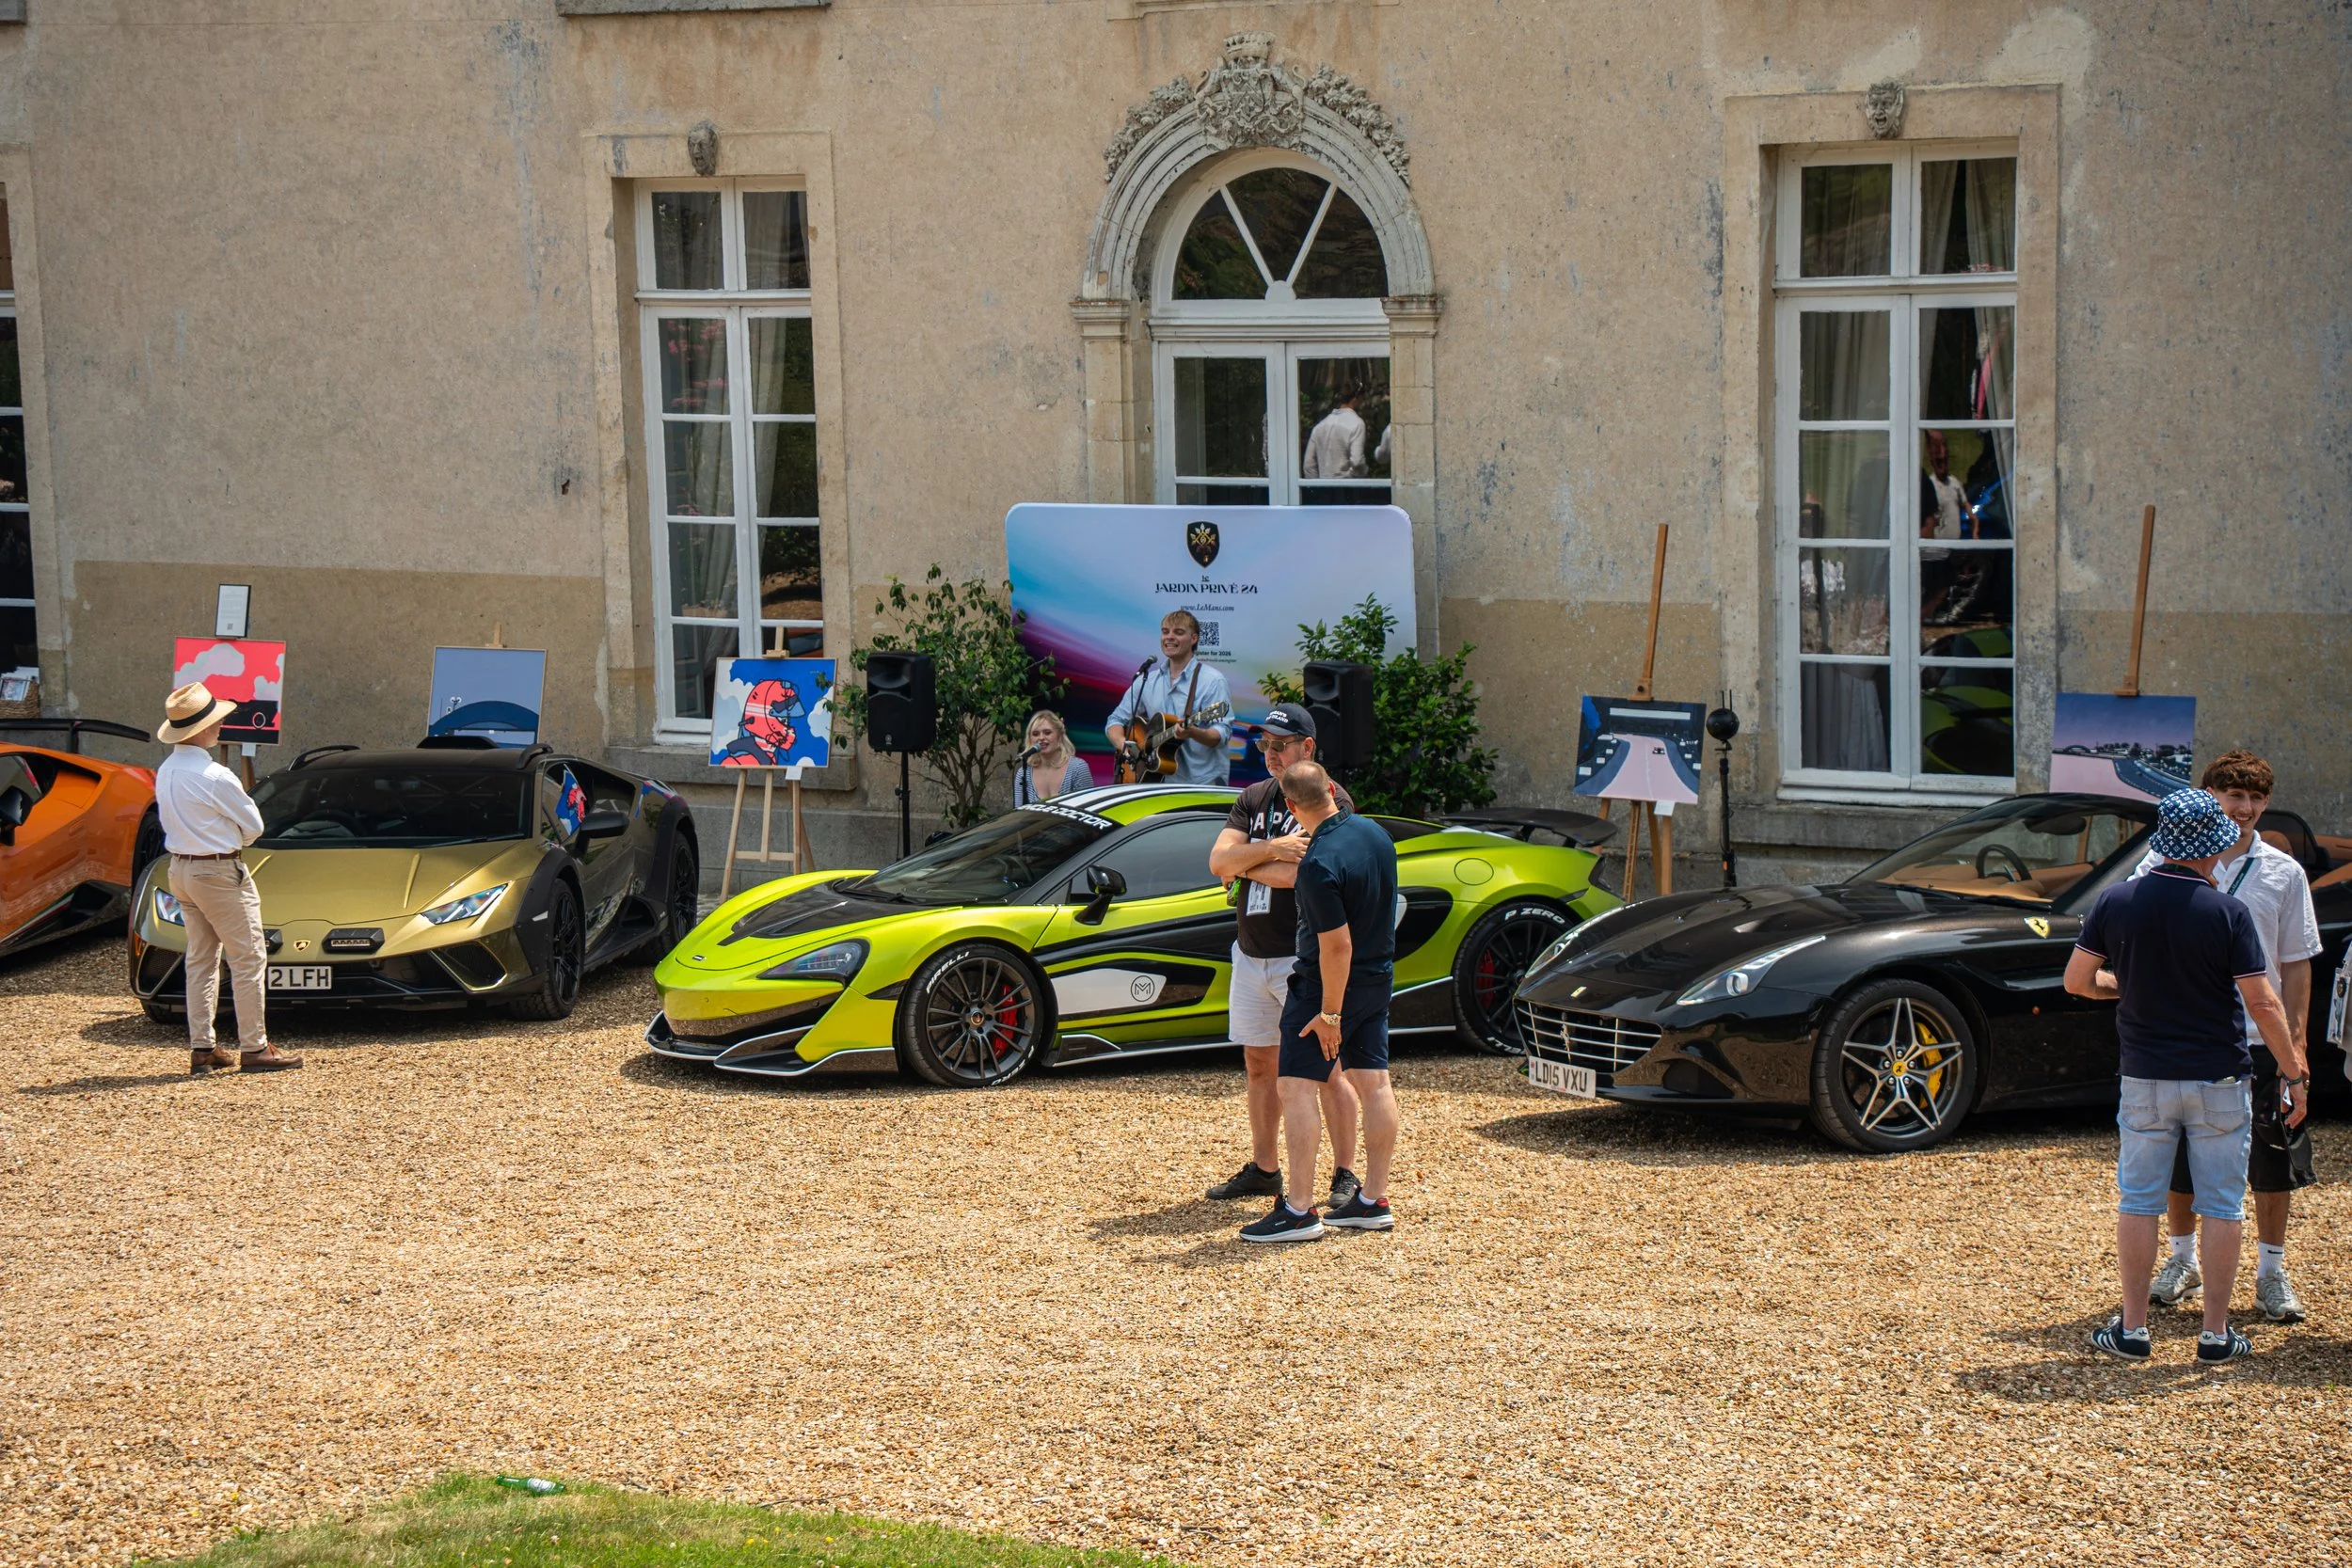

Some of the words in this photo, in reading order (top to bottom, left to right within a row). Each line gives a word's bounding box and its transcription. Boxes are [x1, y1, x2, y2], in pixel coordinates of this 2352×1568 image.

[1155, 583, 1199, 594] JARDIN
[1200, 583, 1239, 594] PRIVÉ
[1241, 584, 1259, 594] 24
[1504, 910, 1518, 921] P
[1520, 908, 1565, 925] ZERO
[271, 969, 283, 987] 2
[289, 969, 329, 987] LFH
[926, 951, 970, 994] PIRELLI
[1534, 1060, 1560, 1086] LD15
[1562, 1067, 1588, 1093] VXU
